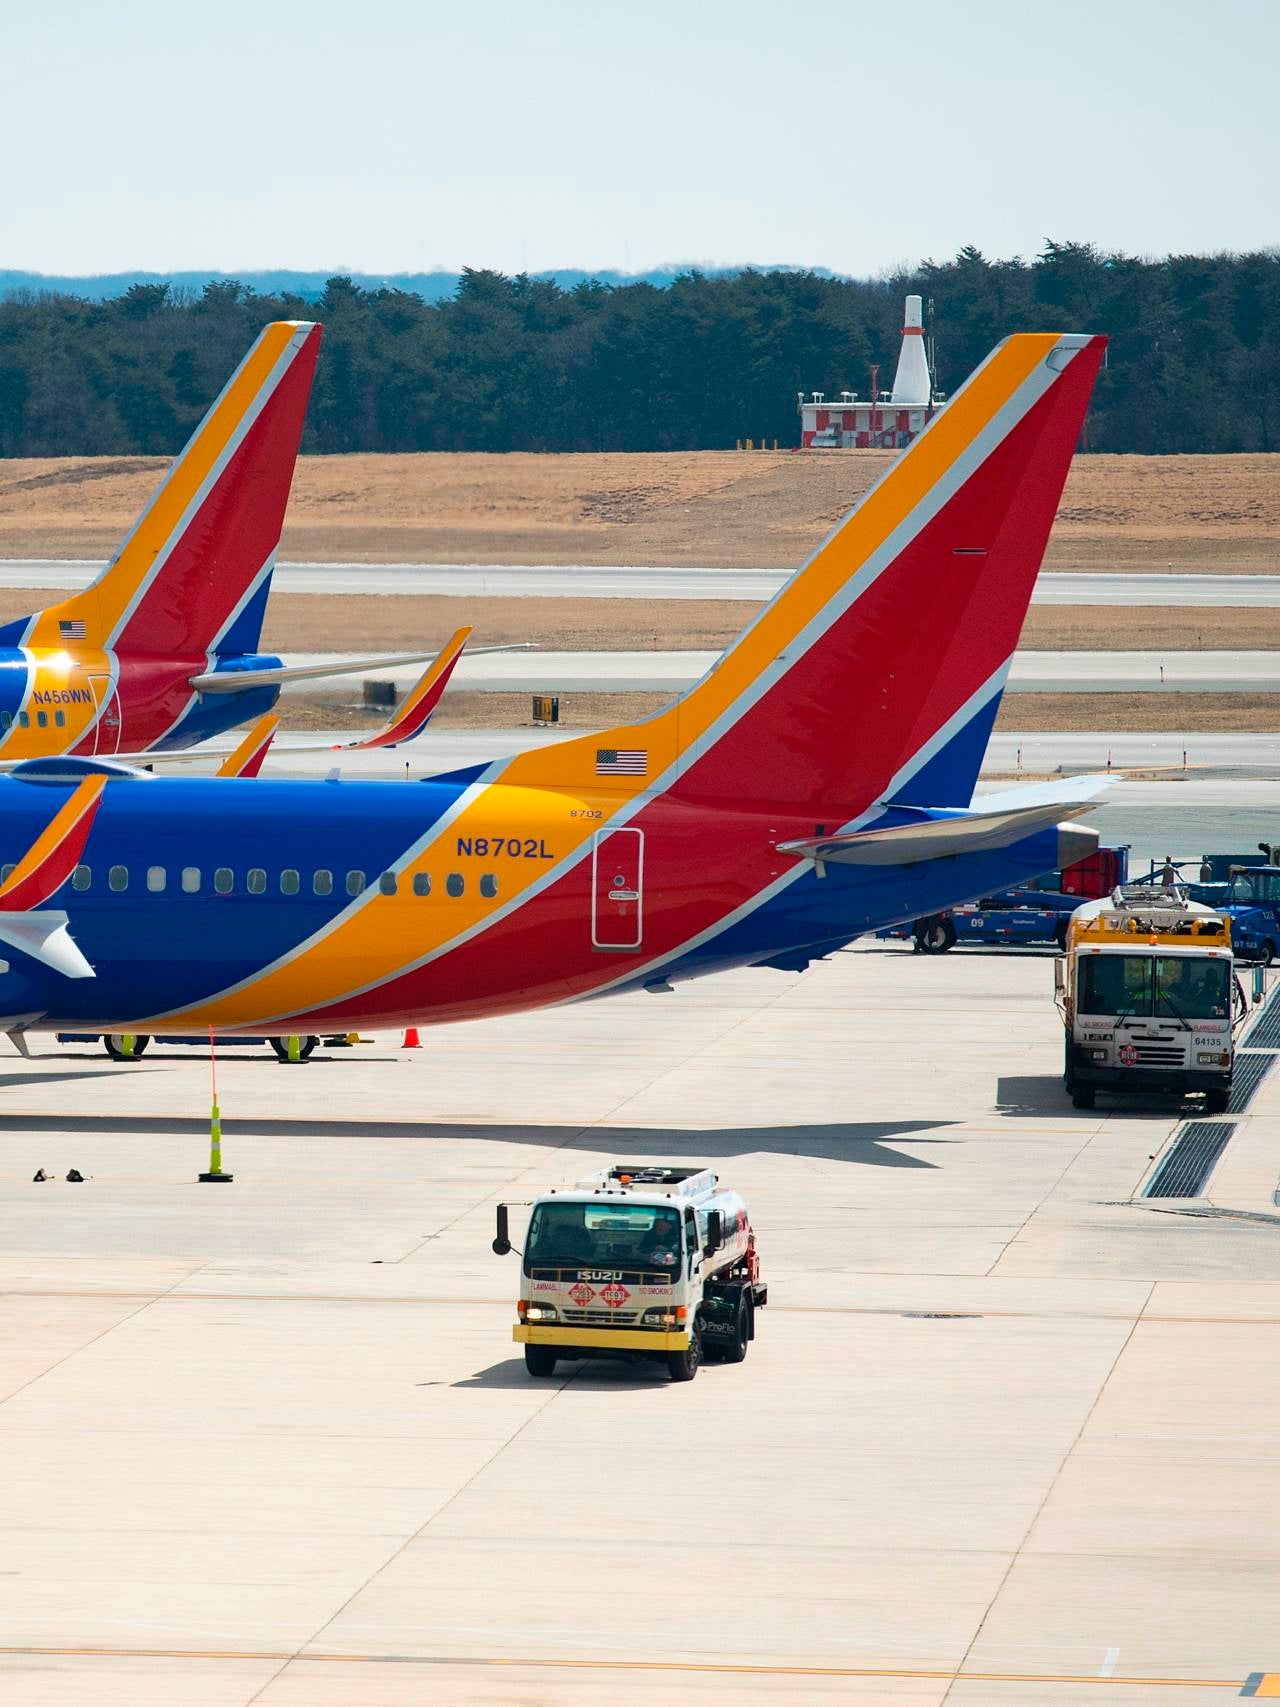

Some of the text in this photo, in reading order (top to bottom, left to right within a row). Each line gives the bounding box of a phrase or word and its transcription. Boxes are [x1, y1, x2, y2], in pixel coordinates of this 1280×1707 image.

[33, 688, 93, 705] N456WN
[570, 809, 603, 819] 8702
[456, 838, 554, 858] N8702L
[970, 918, 984, 928] 09
[1195, 1037, 1222, 1046] 64135
[577, 1271, 623, 1281] ISUZU
